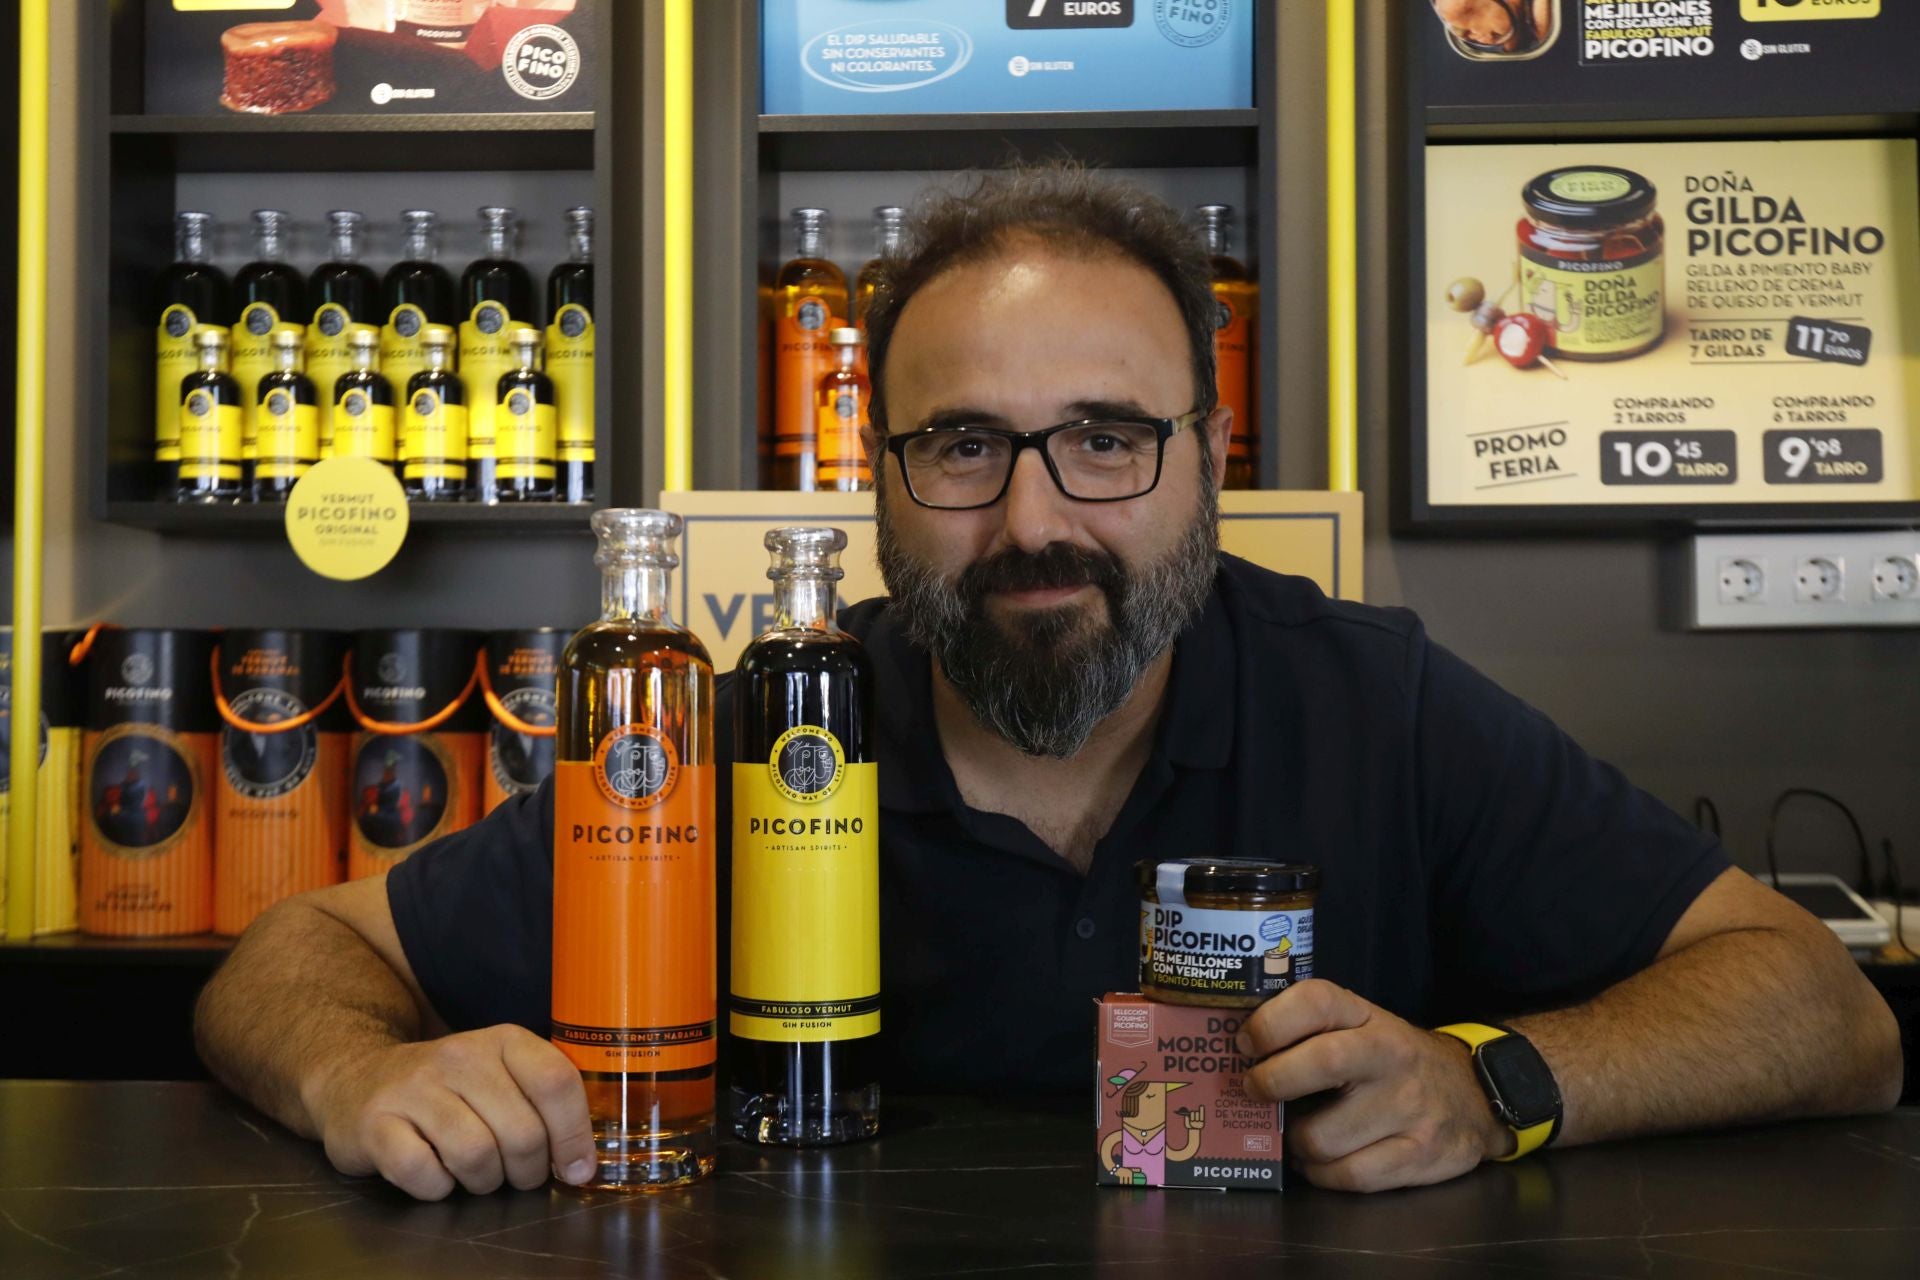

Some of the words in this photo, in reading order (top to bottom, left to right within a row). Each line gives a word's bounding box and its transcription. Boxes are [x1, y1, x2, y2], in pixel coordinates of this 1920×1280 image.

[1064, 2, 1122, 16] EUROS
[1169, 6, 1214, 25] FINO
[1585, 1, 1712, 19] MEJILLONES
[1585, 20, 1615, 29] CON
[1616, 17, 1692, 29] ESCABECHE
[1694, 16, 1712, 26] DE
[827, 35, 843, 45] EL
[845, 34, 866, 45] DIP
[868, 33, 939, 45] SALUDABLE
[1585, 28, 1656, 40] FABULOSO
[1657, 26, 1713, 37] VERMUT
[520, 44, 566, 65] PICO
[822, 48, 843, 59] SIN
[845, 47, 946, 59] CONSERVANTES
[1585, 36, 1715, 59] PICOFINO
[518, 58, 564, 79] FINO
[831, 62, 845, 72] NI
[847, 60, 936, 72] COLORANTES.
[1686, 171, 1754, 193] DOÑA
[1686, 196, 1806, 225] GILDA
[1687, 226, 1885, 257] PICOFINO
[1558, 261, 1624, 271] PICOFINO
[1686, 264, 1733, 277] GILDA
[1736, 264, 1748, 277] &
[1751, 262, 1827, 276] PIMIENTO
[1831, 261, 1872, 275] BABY
[1585, 274, 1637, 291] DOÑA
[1687, 279, 1759, 293] RELLENO
[1763, 279, 1784, 292] DE
[1787, 278, 1845, 292] CREMA
[1585, 291, 1637, 306] GILDA
[1585, 291, 1660, 318] PICOFINO
[1688, 295, 1708, 309] DE
[1712, 294, 1768, 309] QUESO
[1772, 294, 1793, 307] DE
[1796, 294, 1863, 307] VERMUT
[1689, 328, 1745, 341] TARRO
[1751, 328, 1773, 341] DE
[1690, 346, 1699, 357] 7
[1705, 345, 1765, 357] GILDAS
[1824, 345, 1864, 360] EUROS
[1613, 397, 1715, 410] COMPRANDO
[1772, 395, 1876, 409] COMPRANDO
[1614, 412, 1623, 424] 2
[1628, 411, 1687, 424] TARROS
[1773, 411, 1783, 424] 6
[1788, 410, 1847, 423] TARROS
[1473, 428, 1568, 458] PROMO
[1490, 455, 1561, 481] FERIA
[1677, 462, 1729, 477] TARRO
[1814, 461, 1869, 476] TARRO
[322, 493, 375, 503] VERMUT
[298, 507, 397, 521] PICOFINO
[315, 525, 378, 535] ORIGINAL
[781, 728, 820, 743] WELCOME
[772, 763, 797, 799] PICOFINO
[823, 788, 832, 796] OF
[835, 764, 843, 783] LIFE
[750, 817, 864, 835] PICOFINO
[572, 824, 698, 844] PICOFINO
[1155, 908, 1183, 928] DIP
[1155, 927, 1256, 953] PICOFINO
[1153, 950, 1165, 961] DE
[1166, 953, 1243, 969] MEJILLONES
[1153, 962, 1174, 975] CON
[1176, 965, 1228, 980] VERMUT
[1159, 974, 1190, 986] BONITO
[1191, 978, 1209, 988] DEL
[1211, 980, 1246, 990] NORTE
[761, 1005, 811, 1014] FABULOSO
[815, 1004, 852, 1014] VERMUT
[1113, 1007, 1148, 1015] SELECCIÓN
[782, 1021, 797, 1029] GIN
[800, 1021, 832, 1029] FUSION
[1207, 1017, 1241, 1034] DO
[565, 1030, 612, 1042] FABULOSO
[616, 1033, 660, 1042] VERMUT
[664, 1028, 703, 1041] NARANJA
[605, 1050, 622, 1058] GIN
[626, 1050, 660, 1058] FUSION
[1164, 1056, 1254, 1073] PICOFIN
[1215, 1100, 1238, 1108] CON
[1215, 1110, 1229, 1119] DE
[1231, 1110, 1272, 1119] VERMUT
[1223, 1120, 1272, 1130] PICOFINO
[1193, 1166, 1273, 1179] PICOFINO
